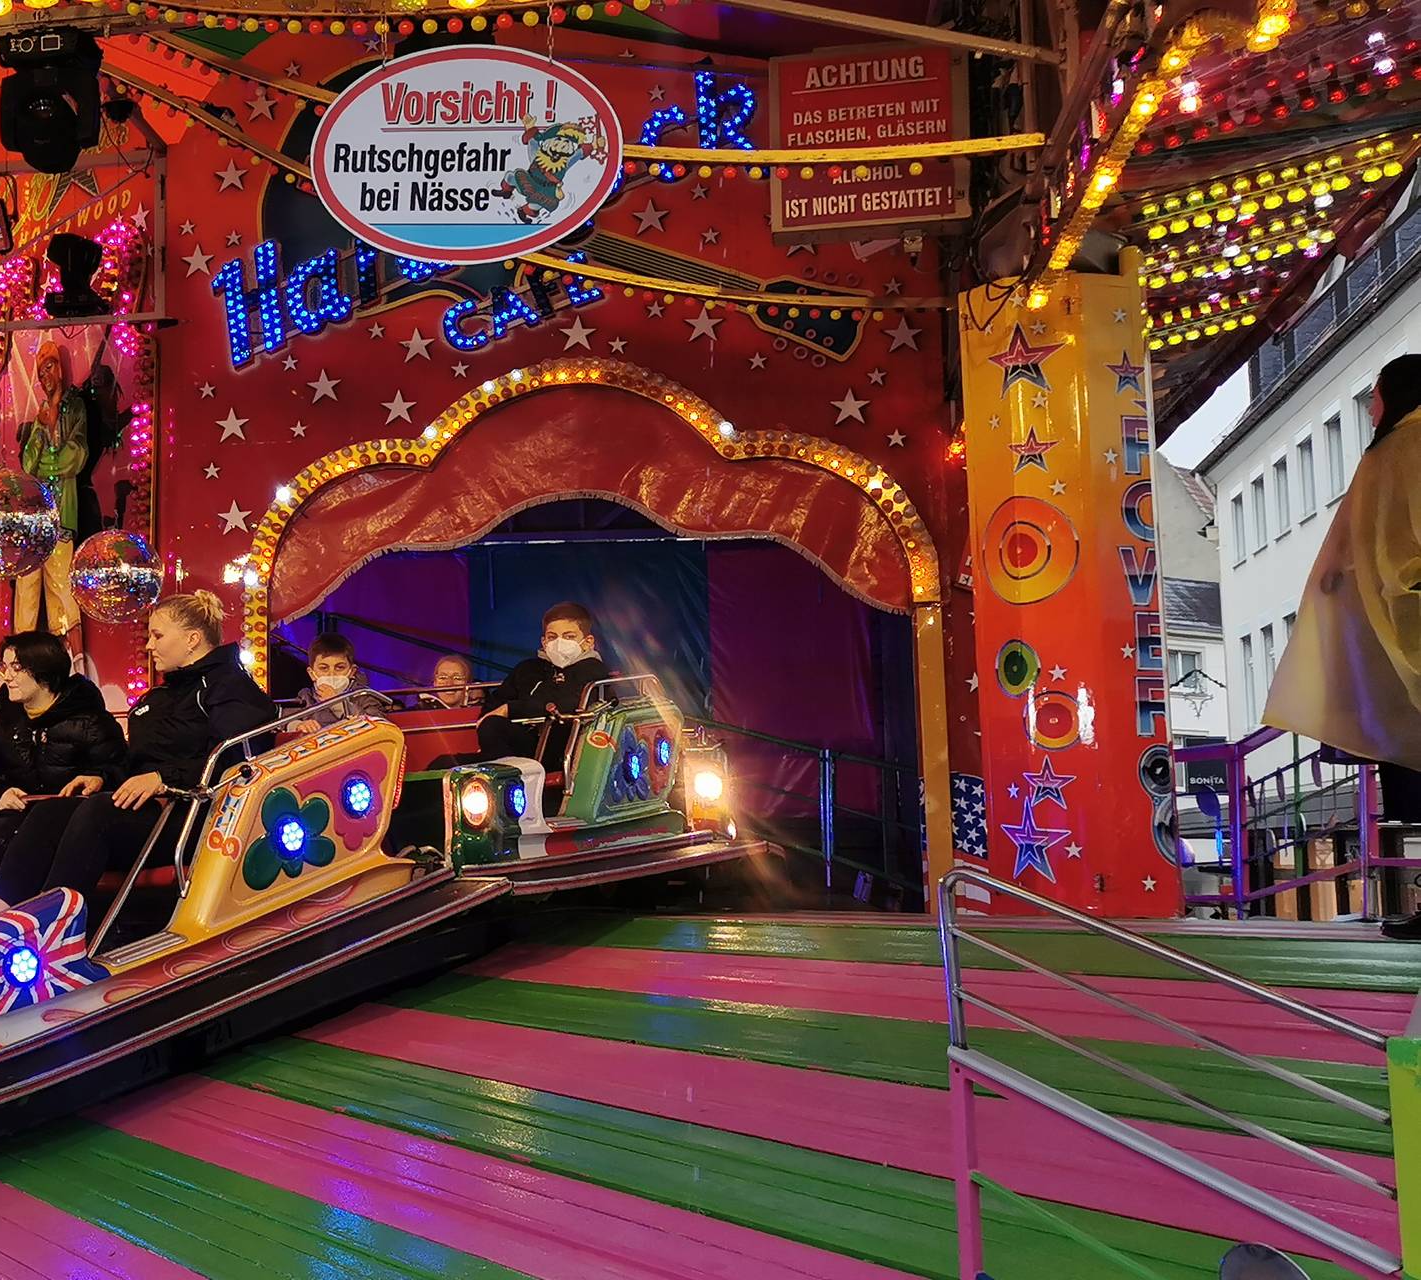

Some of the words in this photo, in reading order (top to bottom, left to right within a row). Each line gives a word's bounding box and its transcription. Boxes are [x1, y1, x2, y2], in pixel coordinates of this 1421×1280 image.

[805, 56, 924, 89] ACHTUNG
[381, 80, 533, 124] Vorsicht
[793, 110, 823, 126] DAS
[828, 102, 905, 123] BETRETEN
[911, 98, 940, 115] MIT
[787, 126, 872, 147] FLASCHEN,
[878, 119, 947, 139] GLÄSERN
[333, 142, 511, 179] Rutschgefahr
[360, 182, 399, 212] bei
[410, 181, 490, 212] Nässe
[785, 198, 809, 219] IST
[812, 194, 857, 217] NICHT
[862, 187, 942, 212] GESTATTET
